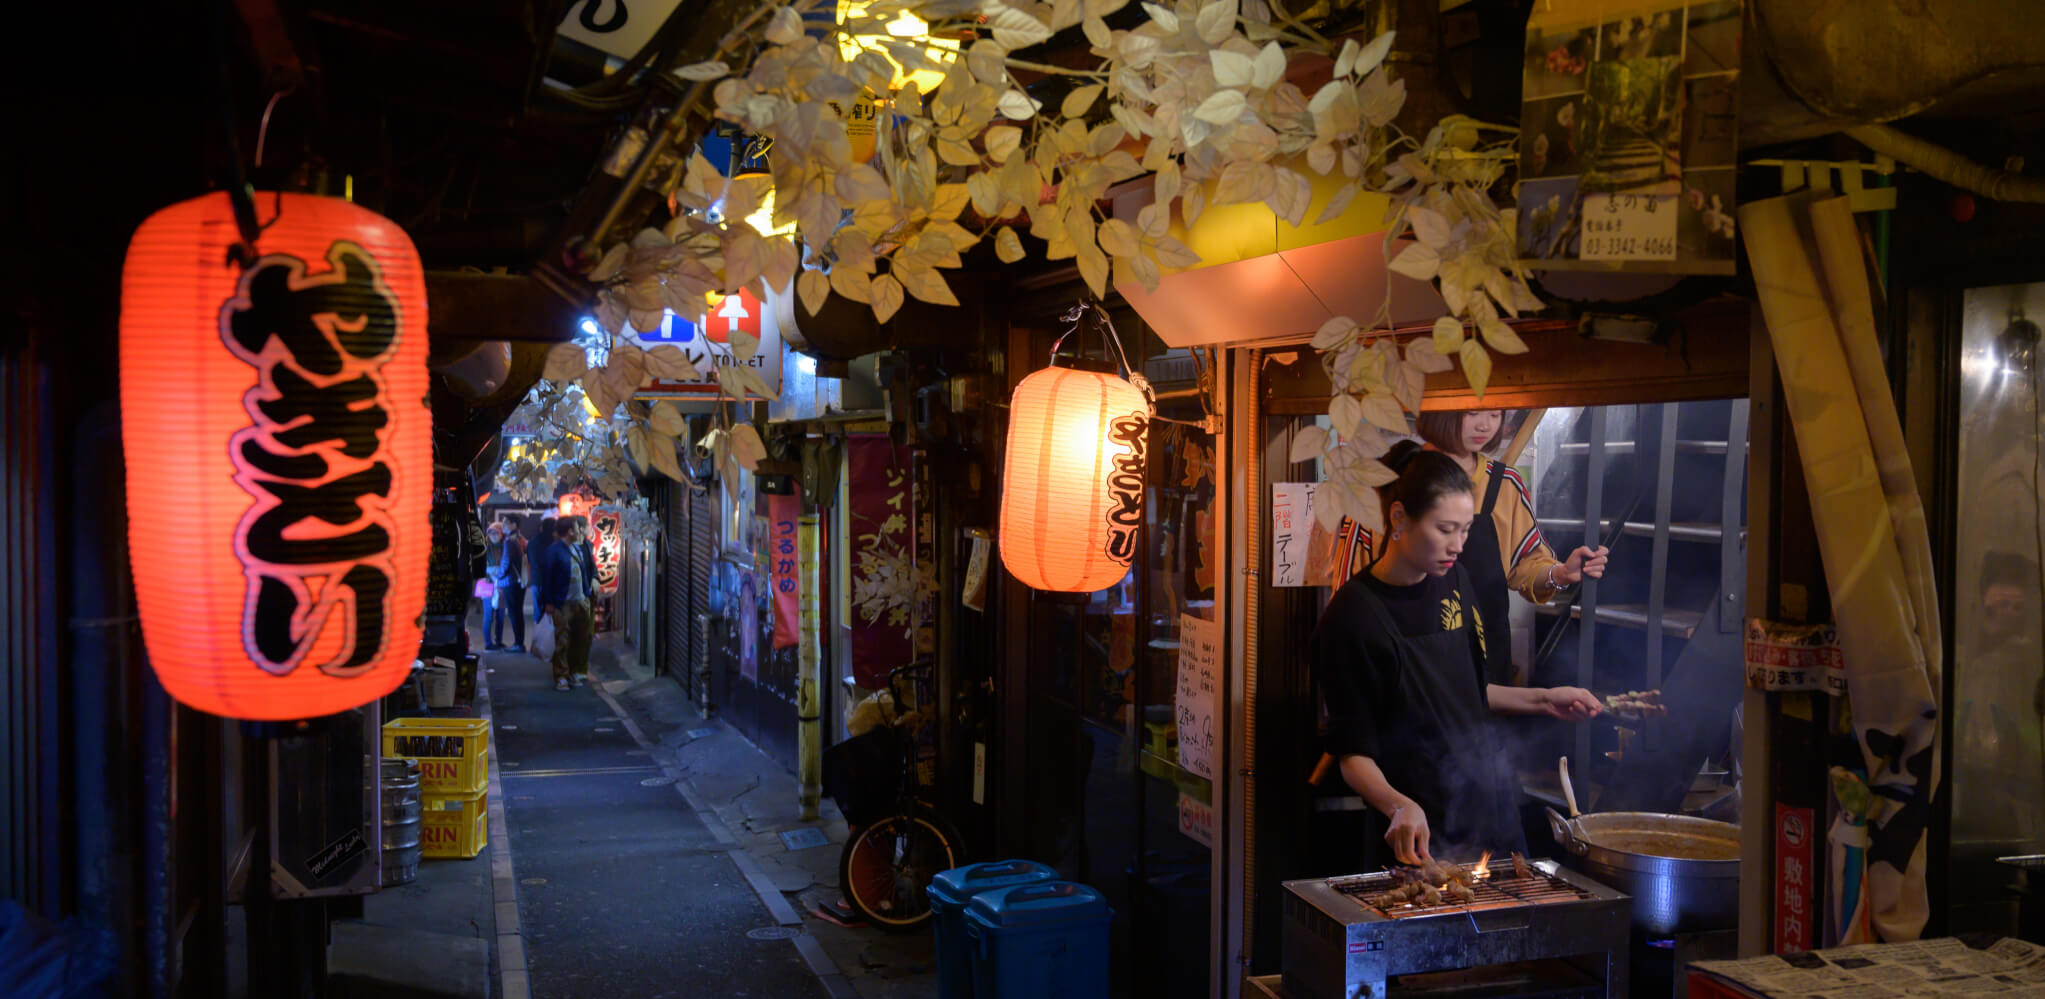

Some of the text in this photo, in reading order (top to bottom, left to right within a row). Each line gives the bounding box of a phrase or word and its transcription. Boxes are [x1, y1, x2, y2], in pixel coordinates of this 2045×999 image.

[1586, 237, 1673, 255] 03-3342-4066
[714, 354, 765, 368] TOIET
[222, 243, 400, 674] やきとり
[1108, 412, 1148, 564] やきとり
[777, 520, 796, 593] つるかめ
